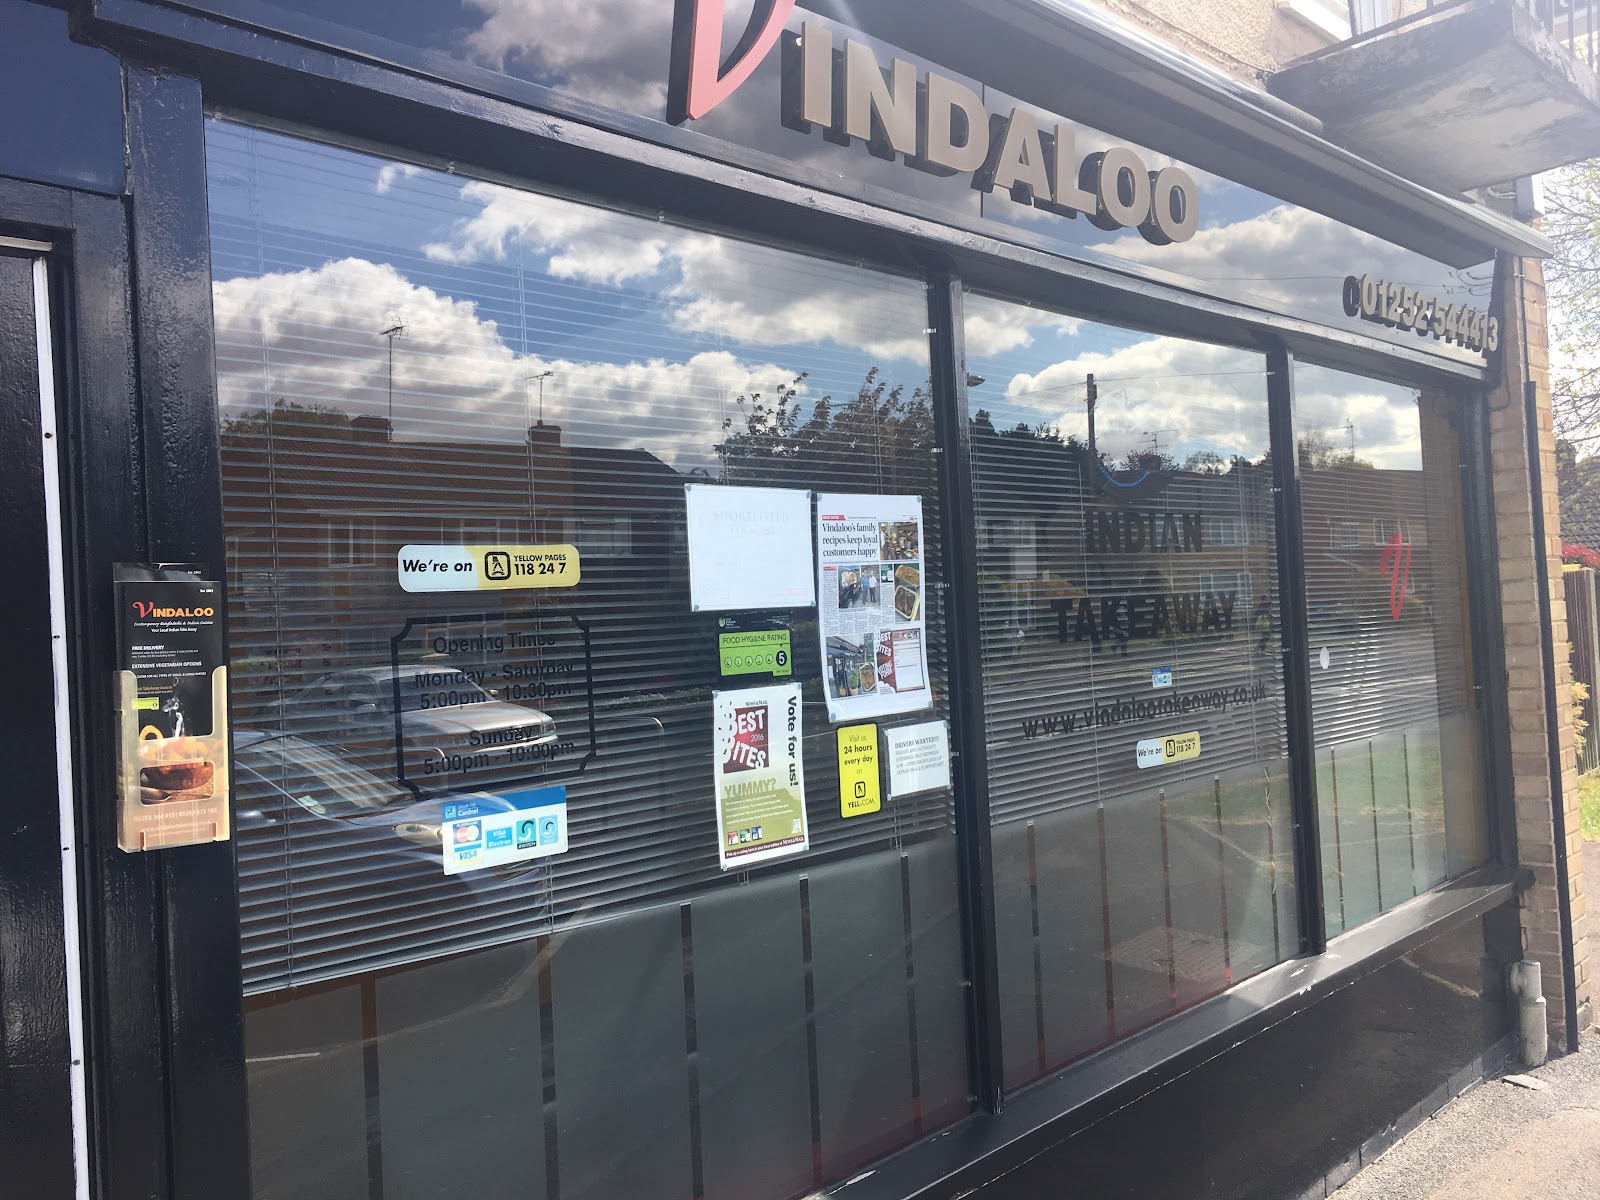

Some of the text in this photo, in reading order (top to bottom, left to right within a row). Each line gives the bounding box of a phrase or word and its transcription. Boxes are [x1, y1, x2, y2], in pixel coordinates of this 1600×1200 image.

[1360, 273, 1498, 352] 01252 544413
[822, 523, 876, 534] Vindaloo's family
[1086, 512, 1203, 553] INDIAN
[822, 535, 878, 546] recipes keep loyal
[822, 547, 877, 557] customers happy
[403, 559, 473, 573] We're on
[514, 562, 566, 576] 118 24 7
[132, 601, 214, 618] VINDALOO
[1051, 591, 1237, 642] TAKEAWAY
[433, 632, 555, 654] Opening Times
[741, 635, 766, 643] HYGIENE
[778, 652, 785, 665] 5
[415, 670, 486, 689] Monday
[503, 663, 574, 680] Saturday
[420, 691, 486, 710] 5:00pm
[504, 682, 572, 700] 10:30pm
[1022, 679, 1266, 738] www.vindalootakeaway.co.uk
[724, 707, 765, 736] BEST
[470, 726, 533, 746] Sunday
[750, 734, 764, 742] 2016
[787, 696, 799, 786] Vote for us!
[844, 744, 873, 754] 24 hours
[895, 741, 915, 749] DRIVERS
[1176, 745, 1184, 753] 118
[1185, 743, 1191, 751] 24
[424, 753, 489, 773] 5:00pm
[507, 742, 574, 760] 10:00pm
[721, 736, 766, 769] BITES
[1138, 748, 1154, 757] We're
[844, 755, 873, 766] every day
[724, 778, 776, 798] YUMMY?
[458, 807, 479, 817] Cardnet
[493, 829, 507, 837] VISA
[488, 839, 512, 848] Electron
[518, 841, 536, 849] SWITCH
[459, 850, 478, 860] VISA
